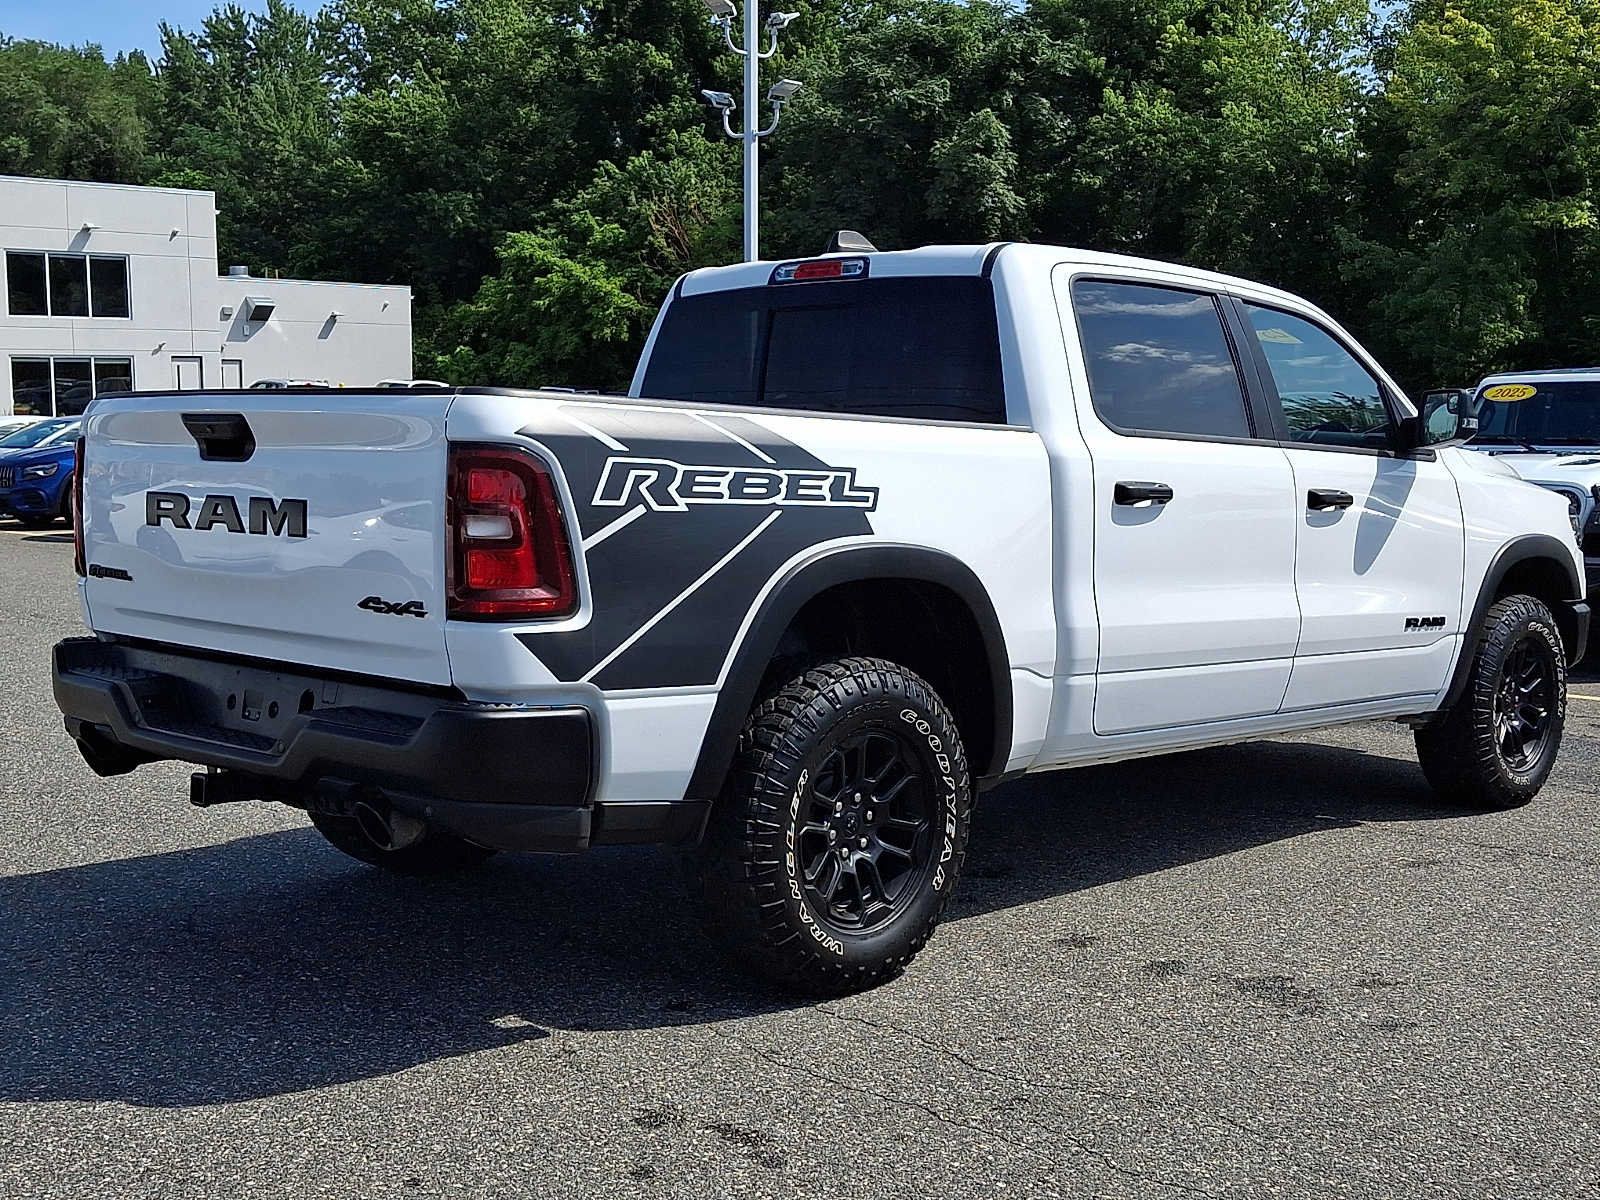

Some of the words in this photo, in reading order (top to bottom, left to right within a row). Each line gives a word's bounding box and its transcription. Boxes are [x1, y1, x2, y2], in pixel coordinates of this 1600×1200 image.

[1491, 387, 1529, 398] 2025
[591, 456, 879, 512] REBEL
[145, 491, 309, 538] RAM
[1405, 616, 1446, 628] RAM
[900, 709, 956, 891] GOODYEAR
[786, 768, 844, 955] WRANGLER
